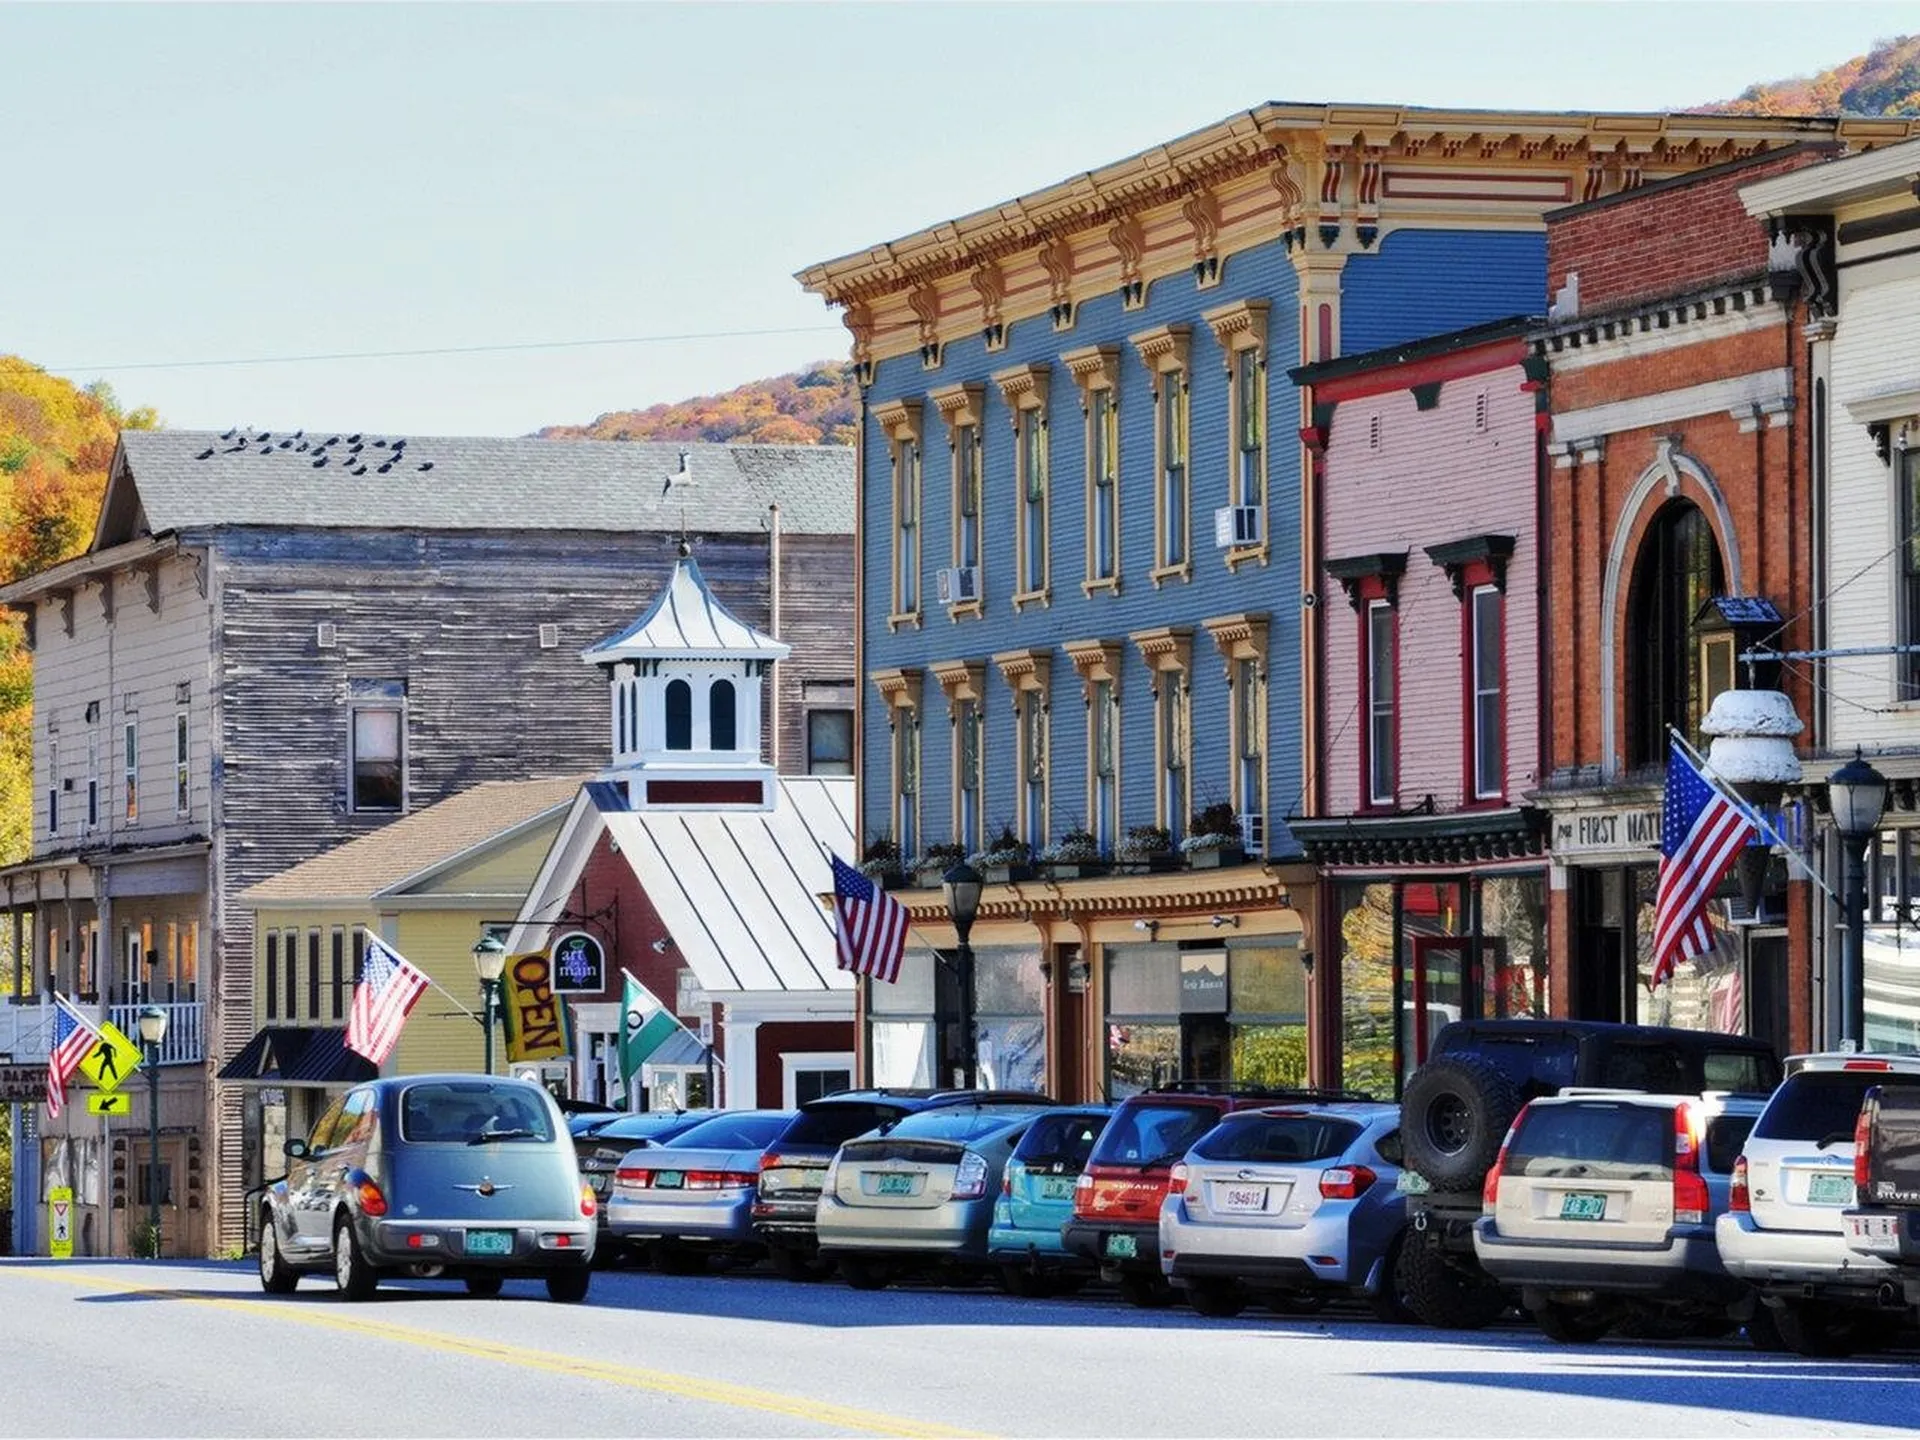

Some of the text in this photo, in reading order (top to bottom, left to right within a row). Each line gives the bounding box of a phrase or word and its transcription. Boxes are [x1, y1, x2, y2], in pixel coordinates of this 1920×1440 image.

[1579, 815, 1617, 845] FIRST
[559, 965, 597, 976] main
[513, 955, 561, 1052] OPEN
[1112, 1183, 1159, 1191] SUBARU
[1877, 1191, 1920, 1201] SILVER
